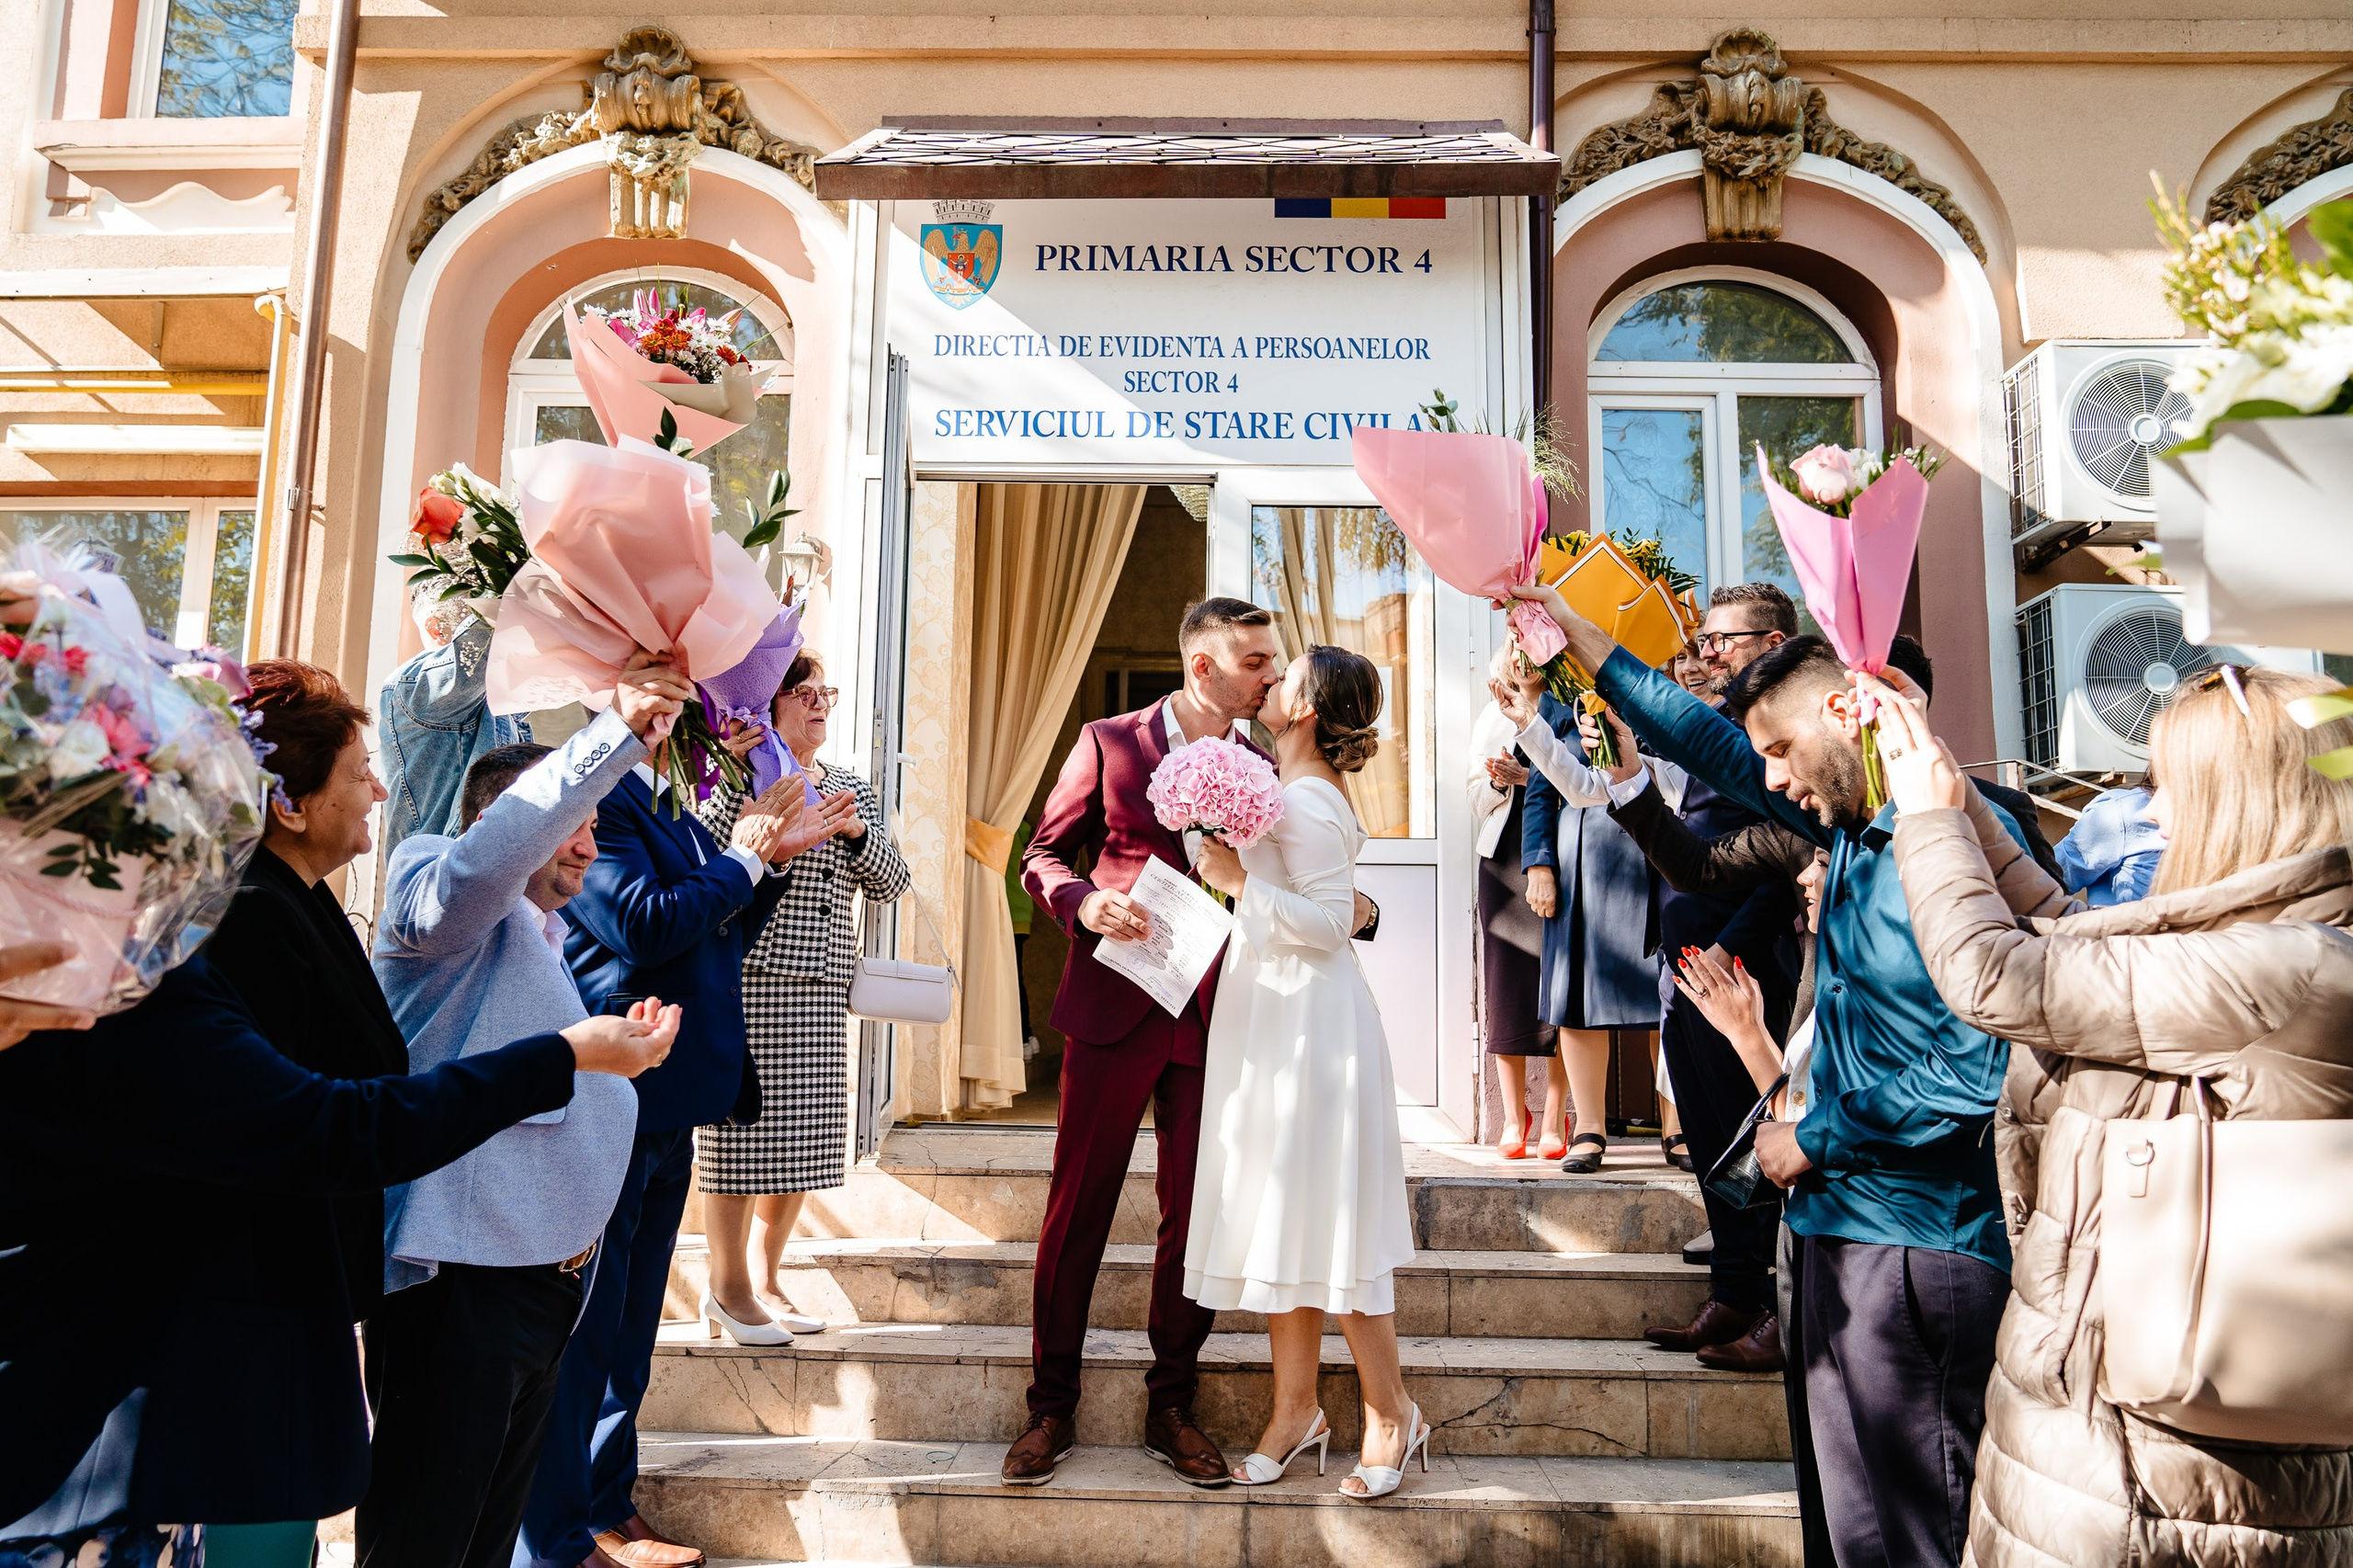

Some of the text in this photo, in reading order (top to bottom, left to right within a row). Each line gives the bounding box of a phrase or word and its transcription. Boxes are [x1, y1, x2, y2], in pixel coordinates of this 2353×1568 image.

[1036, 244, 1433, 273] PRIMARIA SECTOR 4
[934, 334, 1430, 361] DIRECTIA DE EVIDENTA A PERSOANELOR
[1123, 369, 1239, 394] SECTOR 4
[935, 409, 1115, 439] SERVICIUL
[1125, 410, 1175, 438] DE
[1184, 409, 1295, 440] STARE
